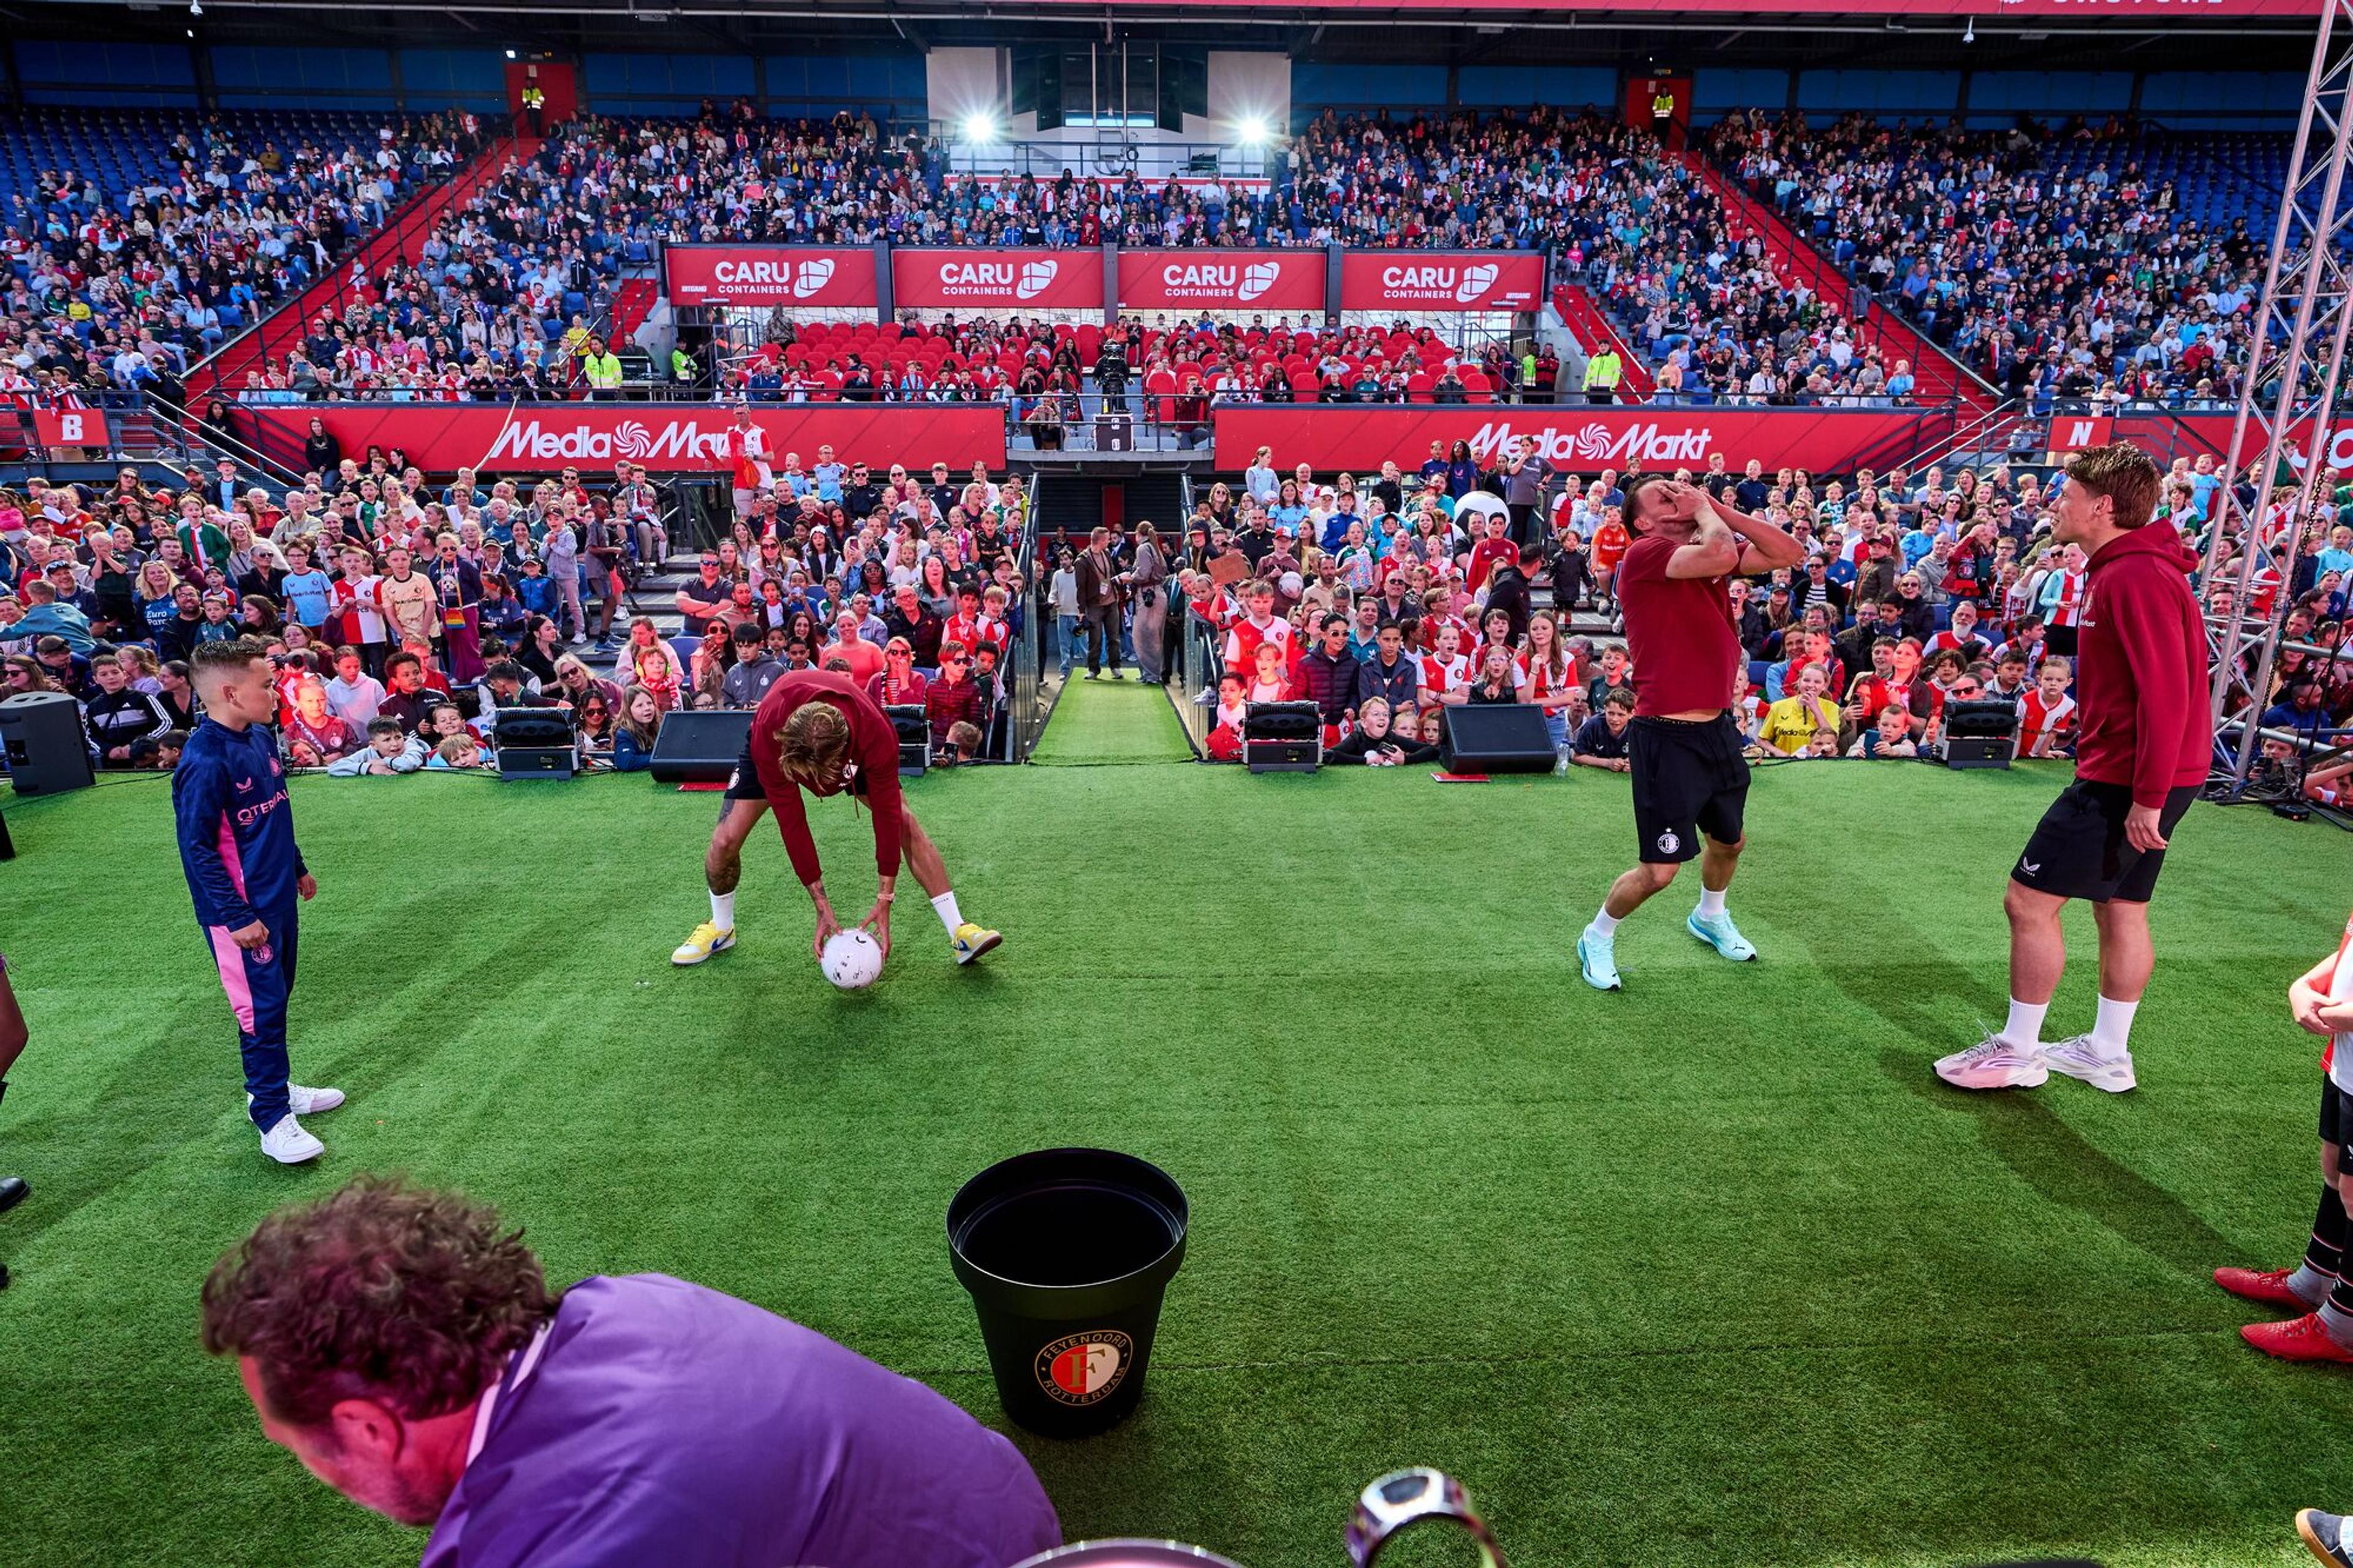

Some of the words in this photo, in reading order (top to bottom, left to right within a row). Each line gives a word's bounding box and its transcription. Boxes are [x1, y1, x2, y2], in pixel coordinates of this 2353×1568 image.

[714, 260, 790, 284] CARU
[939, 263, 1014, 284] CARU
[1163, 264, 1236, 286] CARU
[1382, 267, 1455, 288] CARU
[718, 285, 790, 294] CONTAINERS
[942, 286, 1013, 295] CONTAINERS
[1165, 288, 1234, 297] CONTAINERS
[1383, 290, 1453, 299] CONTAINERS
[62, 414, 83, 441] B
[2067, 421, 2094, 446] N
[489, 421, 612, 458] Media
[645, 421, 729, 458] Mar
[1468, 423, 1575, 460] Media
[1604, 423, 1713, 460] Markt
[1043, 1333, 1127, 1360] FEYENOORD
[1043, 1366, 1126, 1403] ROTTERDAM
